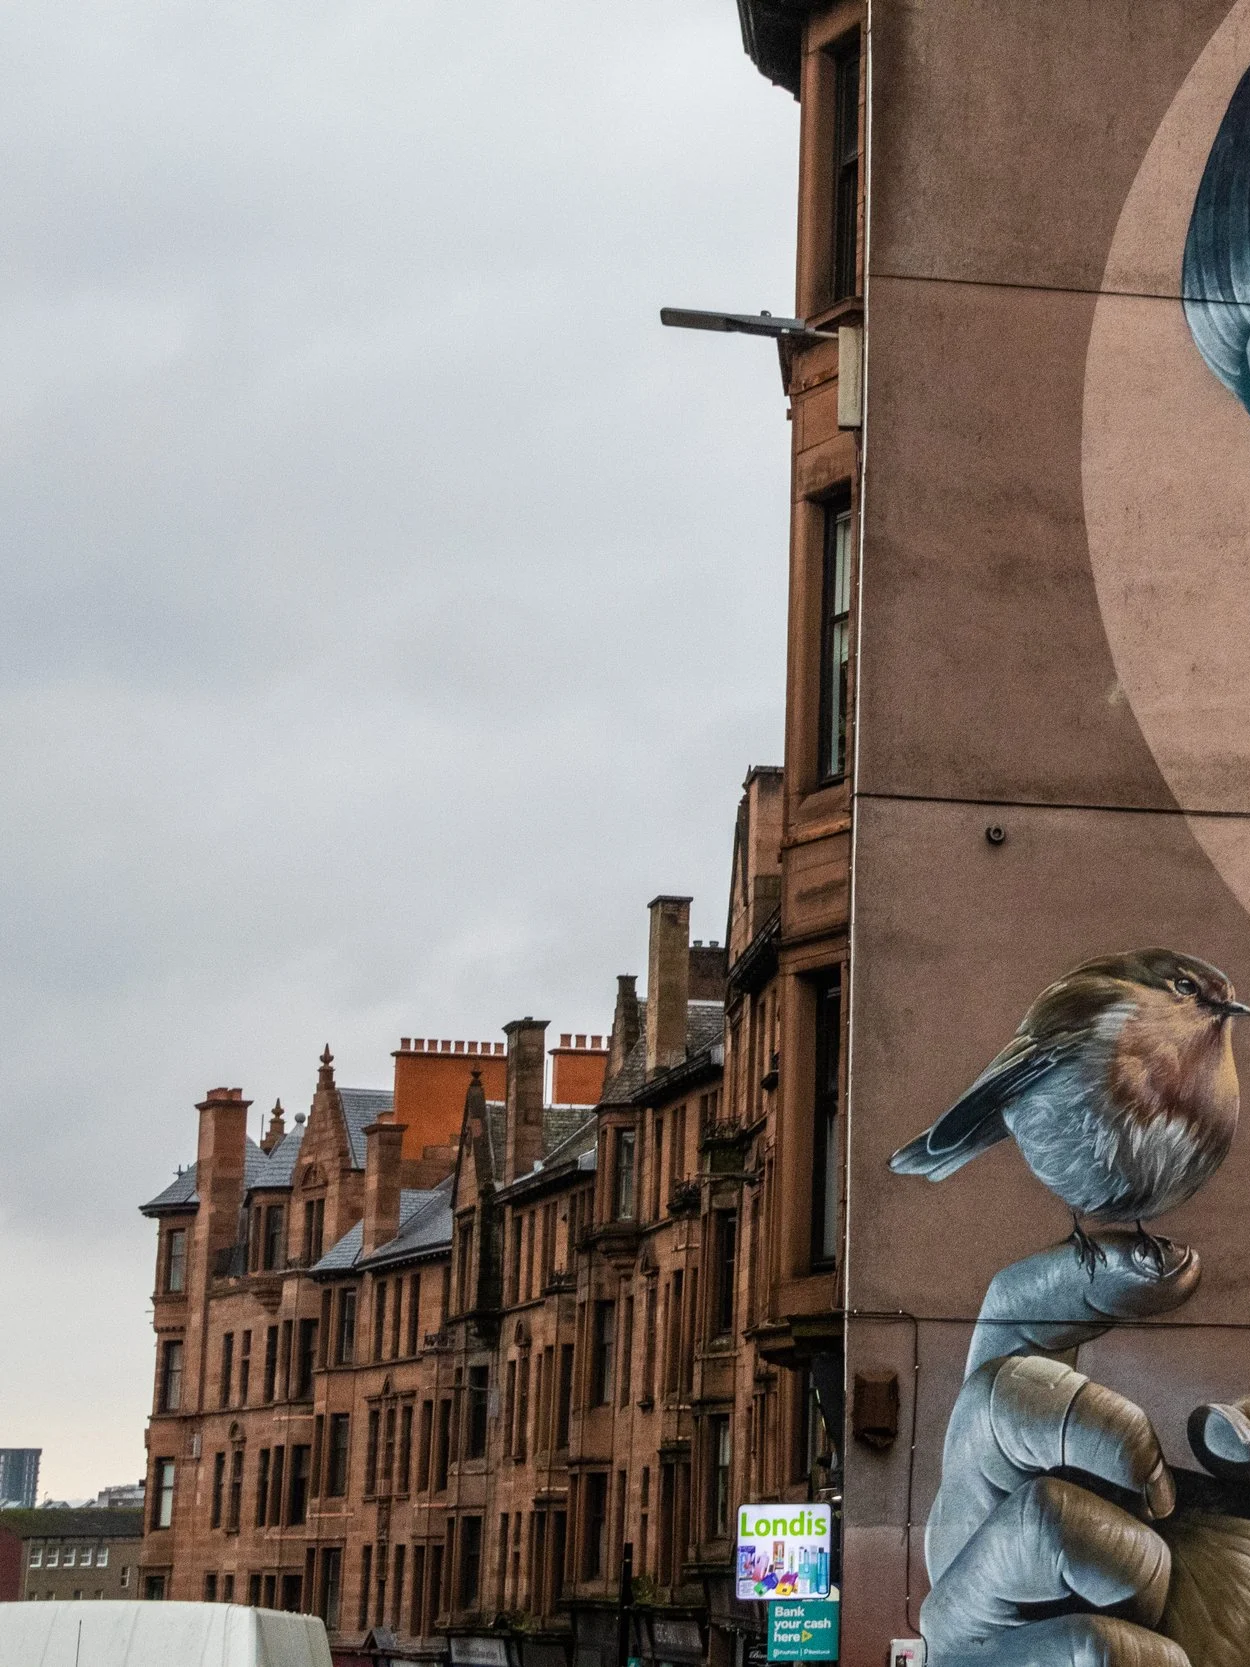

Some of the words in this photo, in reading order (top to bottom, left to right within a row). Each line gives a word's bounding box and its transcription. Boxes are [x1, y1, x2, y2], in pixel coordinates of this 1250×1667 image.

[740, 1511, 827, 1537] Londis
[774, 1606, 805, 1617] Bank
[773, 1620, 802, 1631] your
[804, 1617, 832, 1628] cash
[773, 1630, 801, 1642] here
